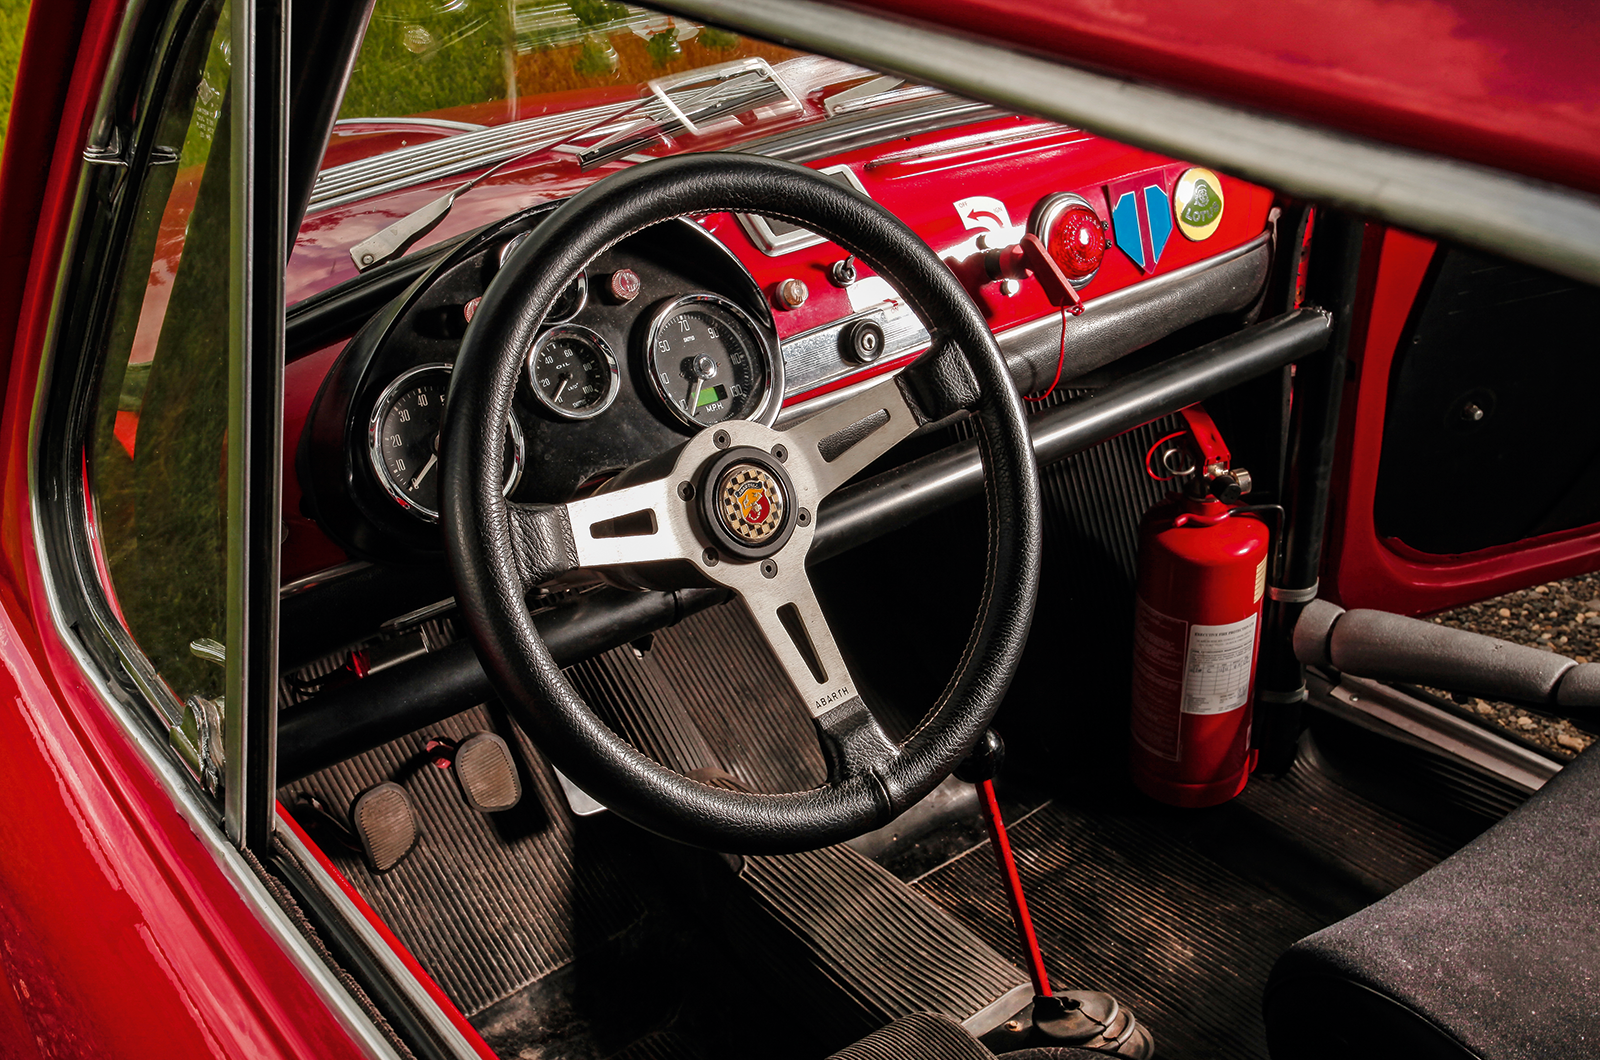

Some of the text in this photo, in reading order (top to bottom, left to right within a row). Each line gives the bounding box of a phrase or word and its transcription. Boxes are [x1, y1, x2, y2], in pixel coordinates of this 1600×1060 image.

[958, 201, 968, 209] OFF
[1185, 201, 1219, 222] LOTUS
[677, 319, 691, 333] 70
[707, 327, 720, 339] 90
[563, 348, 574, 358] 60
[658, 339, 671, 353] 50
[544, 355, 554, 365] 40
[555, 362, 571, 370] OIL
[730, 352, 742, 366] 110
[582, 362, 593, 372] 80
[540, 377, 551, 388] 20
[582, 384, 594, 395] 100
[729, 383, 744, 398] 130
[417, 393, 429, 408] 40
[399, 409, 411, 423] 30
[390, 433, 403, 448] 20
[395, 458, 406, 472] 10
[815, 686, 849, 709] ABARTH
